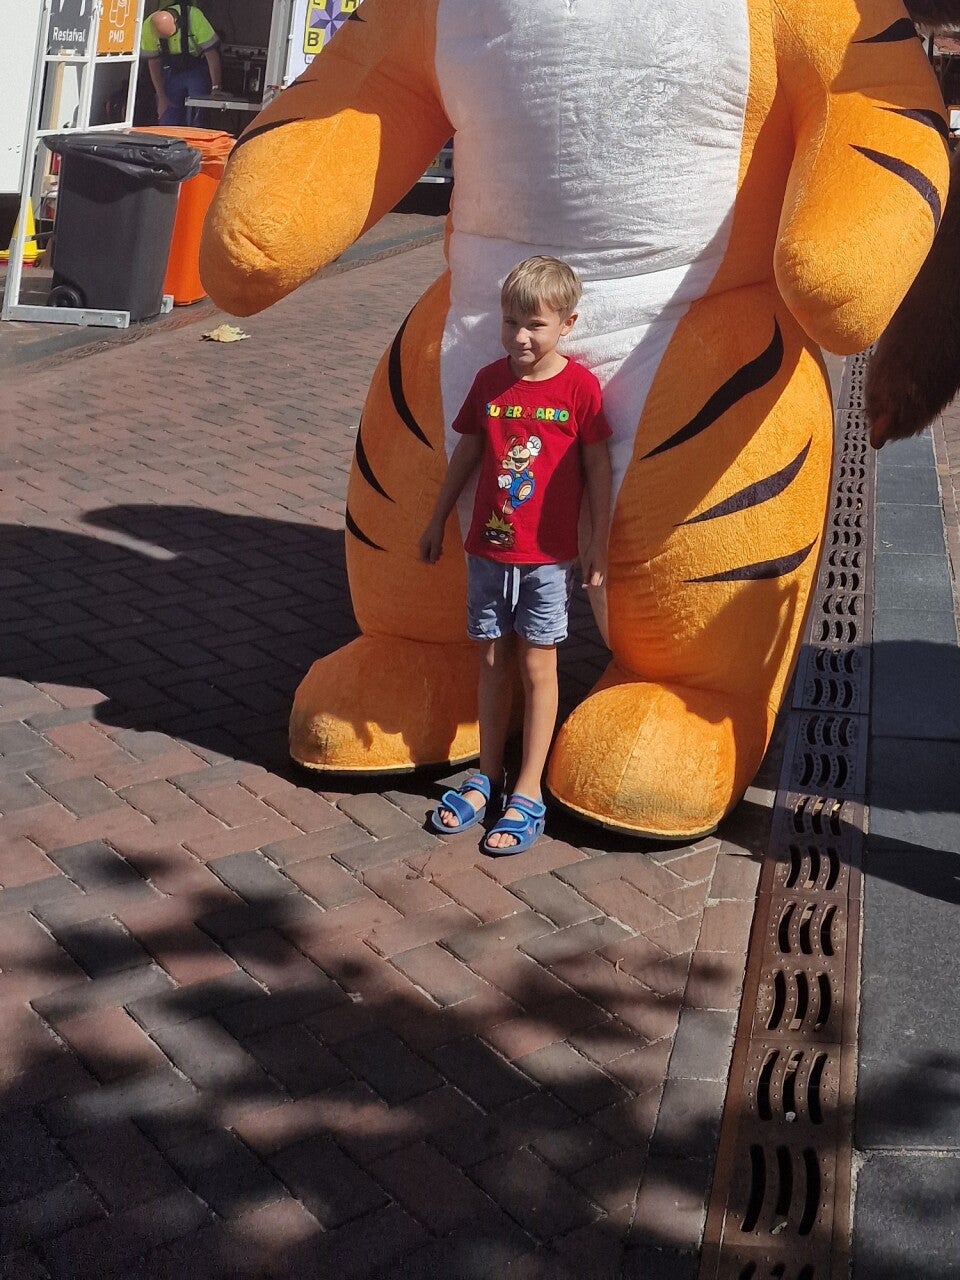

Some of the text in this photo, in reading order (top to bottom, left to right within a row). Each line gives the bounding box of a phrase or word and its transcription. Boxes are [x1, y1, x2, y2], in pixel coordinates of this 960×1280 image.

[52, 26, 86, 42] Restafval
[108, 29, 125, 43] PMD
[522, 406, 570, 422] MARIO
